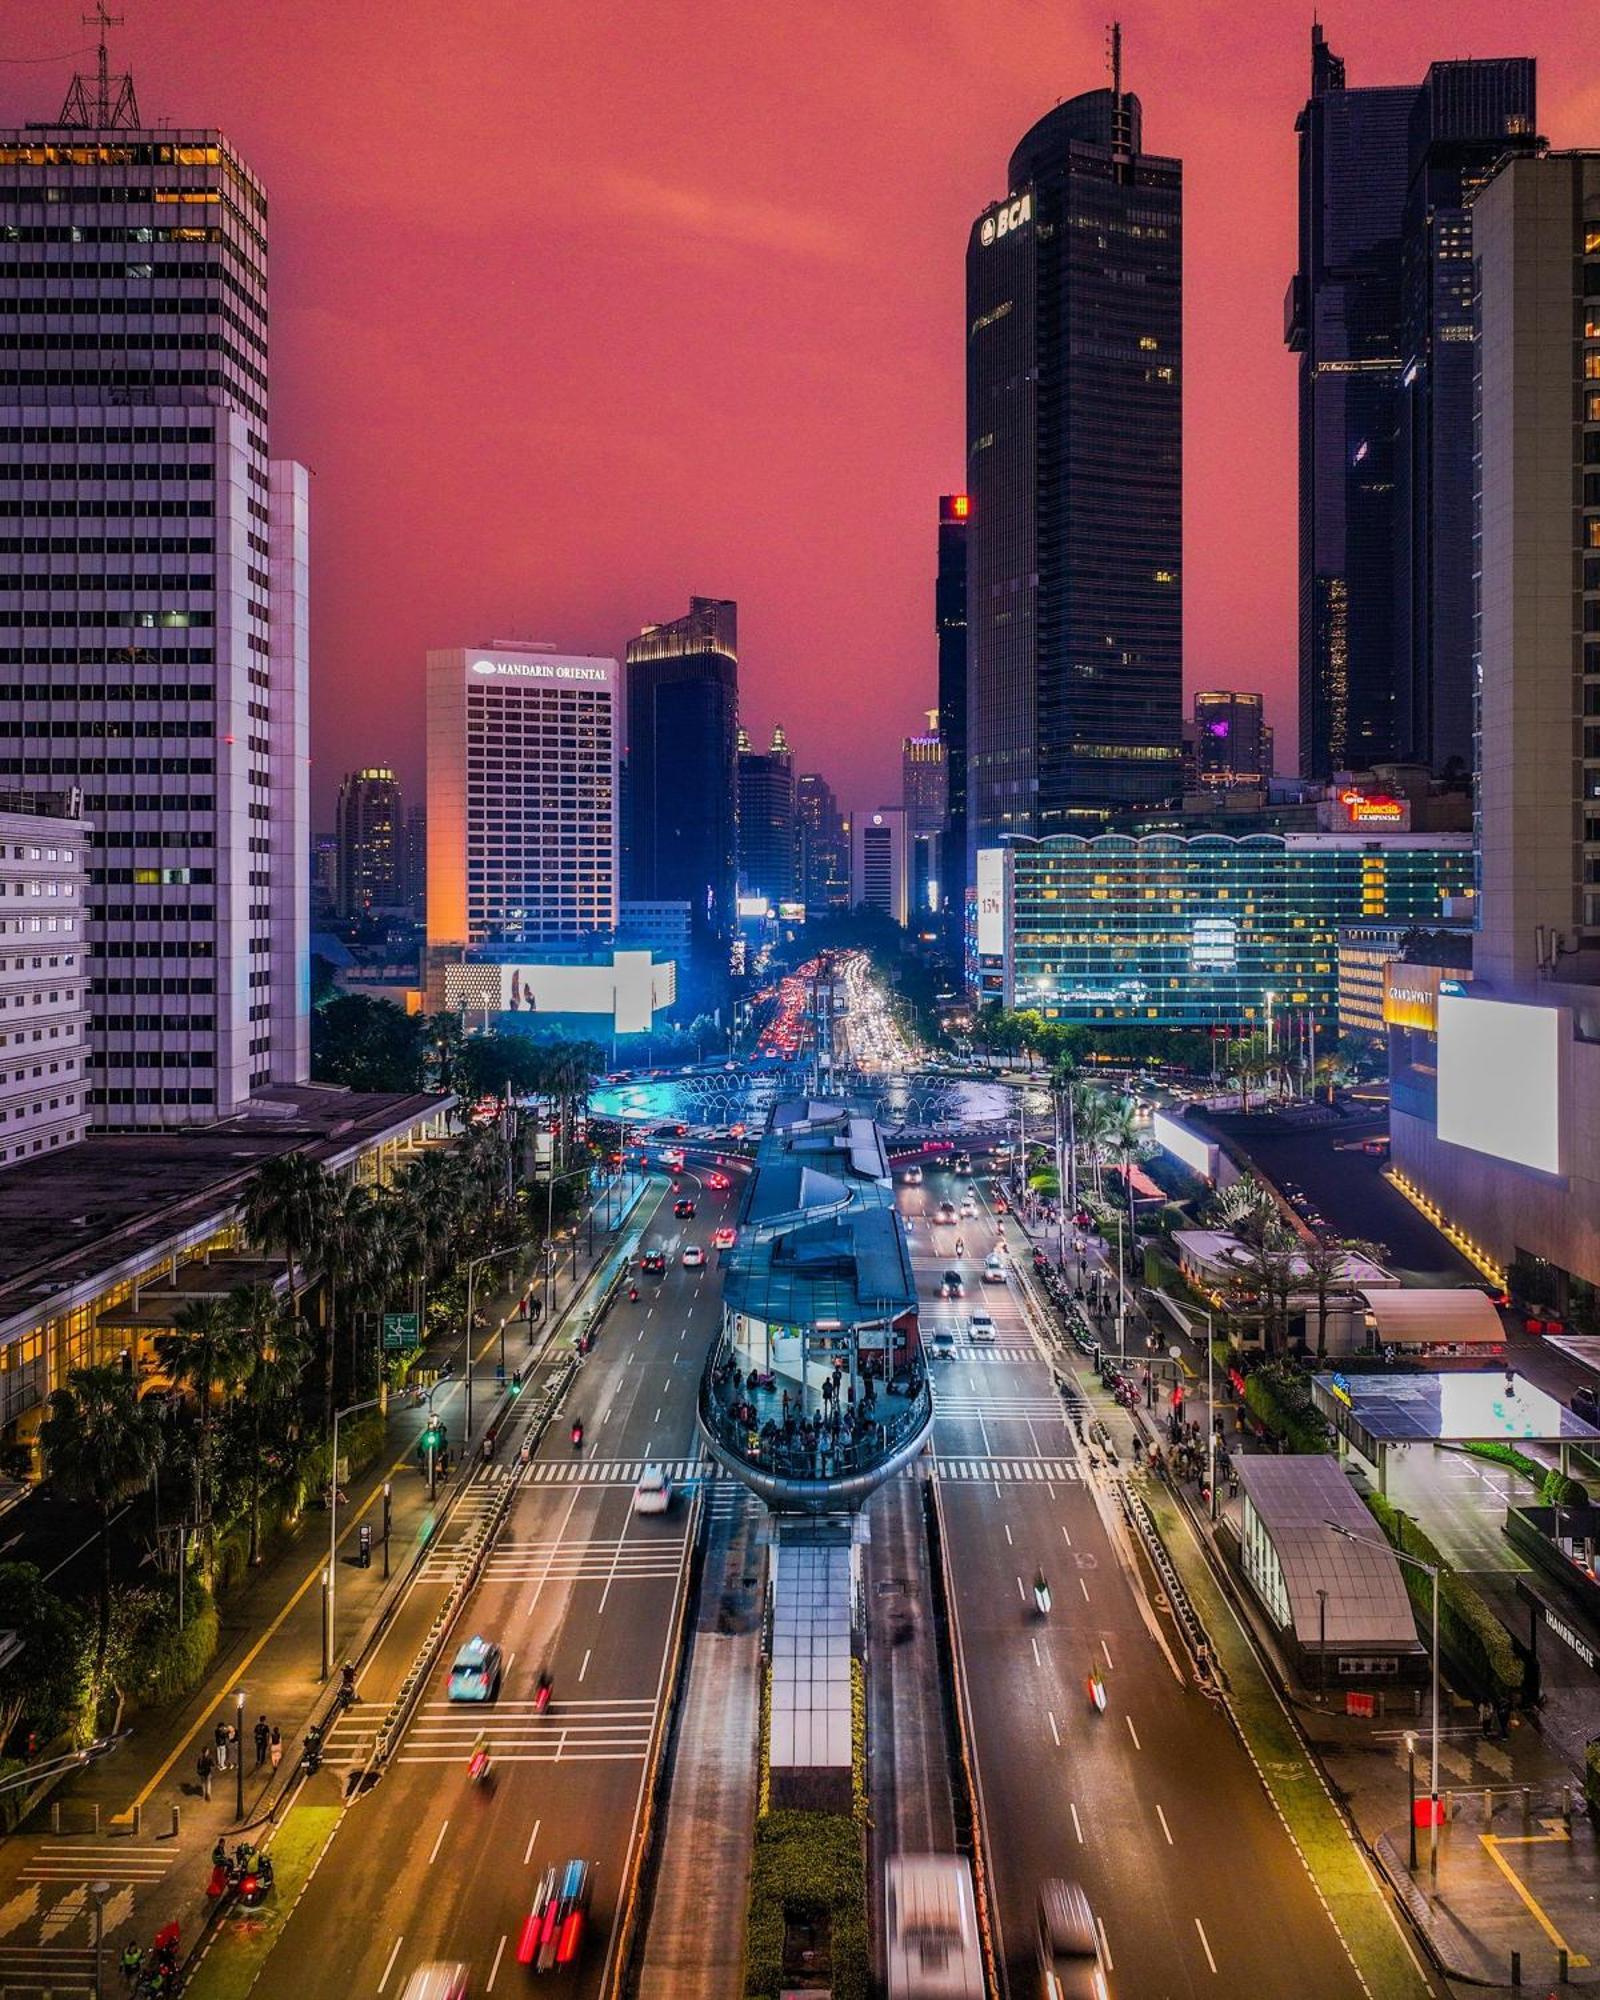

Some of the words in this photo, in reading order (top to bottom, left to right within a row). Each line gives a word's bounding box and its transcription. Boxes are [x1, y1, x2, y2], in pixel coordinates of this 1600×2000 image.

[996, 194, 1031, 238] BCA
[497, 663, 554, 677] MANDARIN
[556, 667, 608, 680] ORIENTAL
[1545, 1608, 1575, 1649] THAMRIN
[1575, 1639, 1594, 1668] GATE
